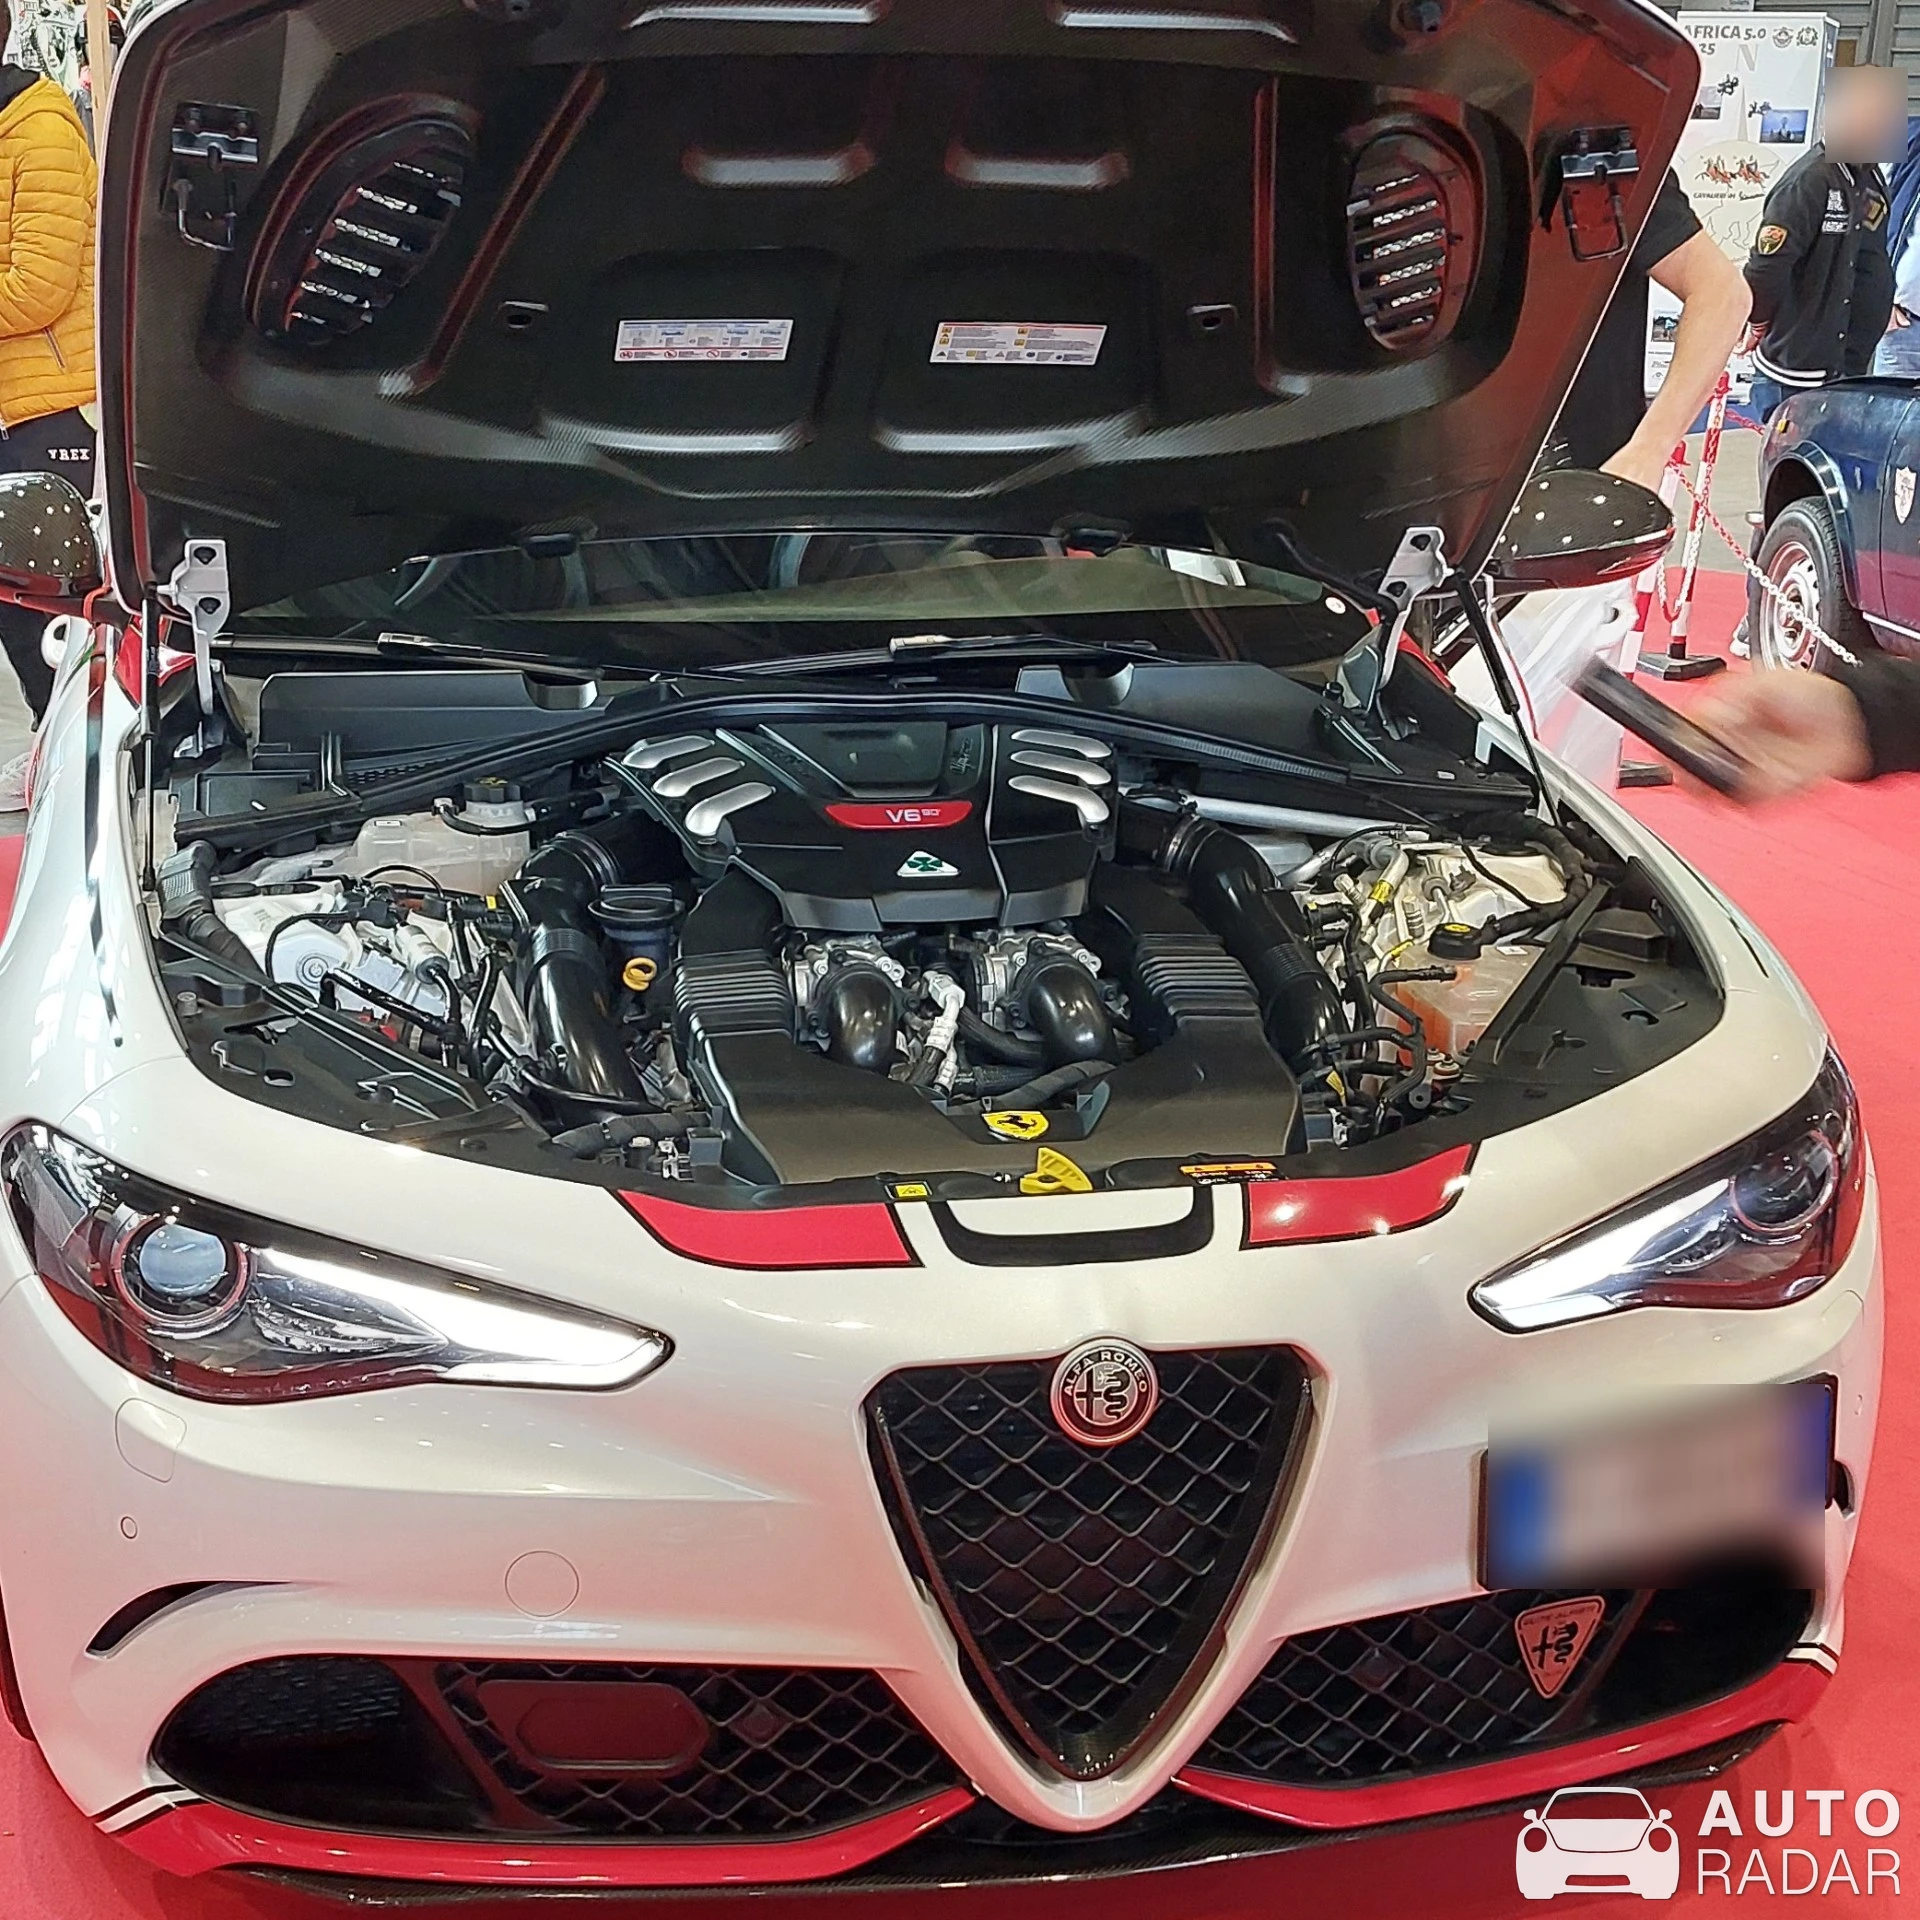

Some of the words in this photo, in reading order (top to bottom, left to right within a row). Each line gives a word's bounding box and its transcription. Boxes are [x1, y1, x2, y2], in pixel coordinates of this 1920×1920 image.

[1743, 28, 1767, 41] 5.0
[1063, 1357, 1094, 1396] ALFA
[1100, 1351, 1148, 1393] ROMEO
